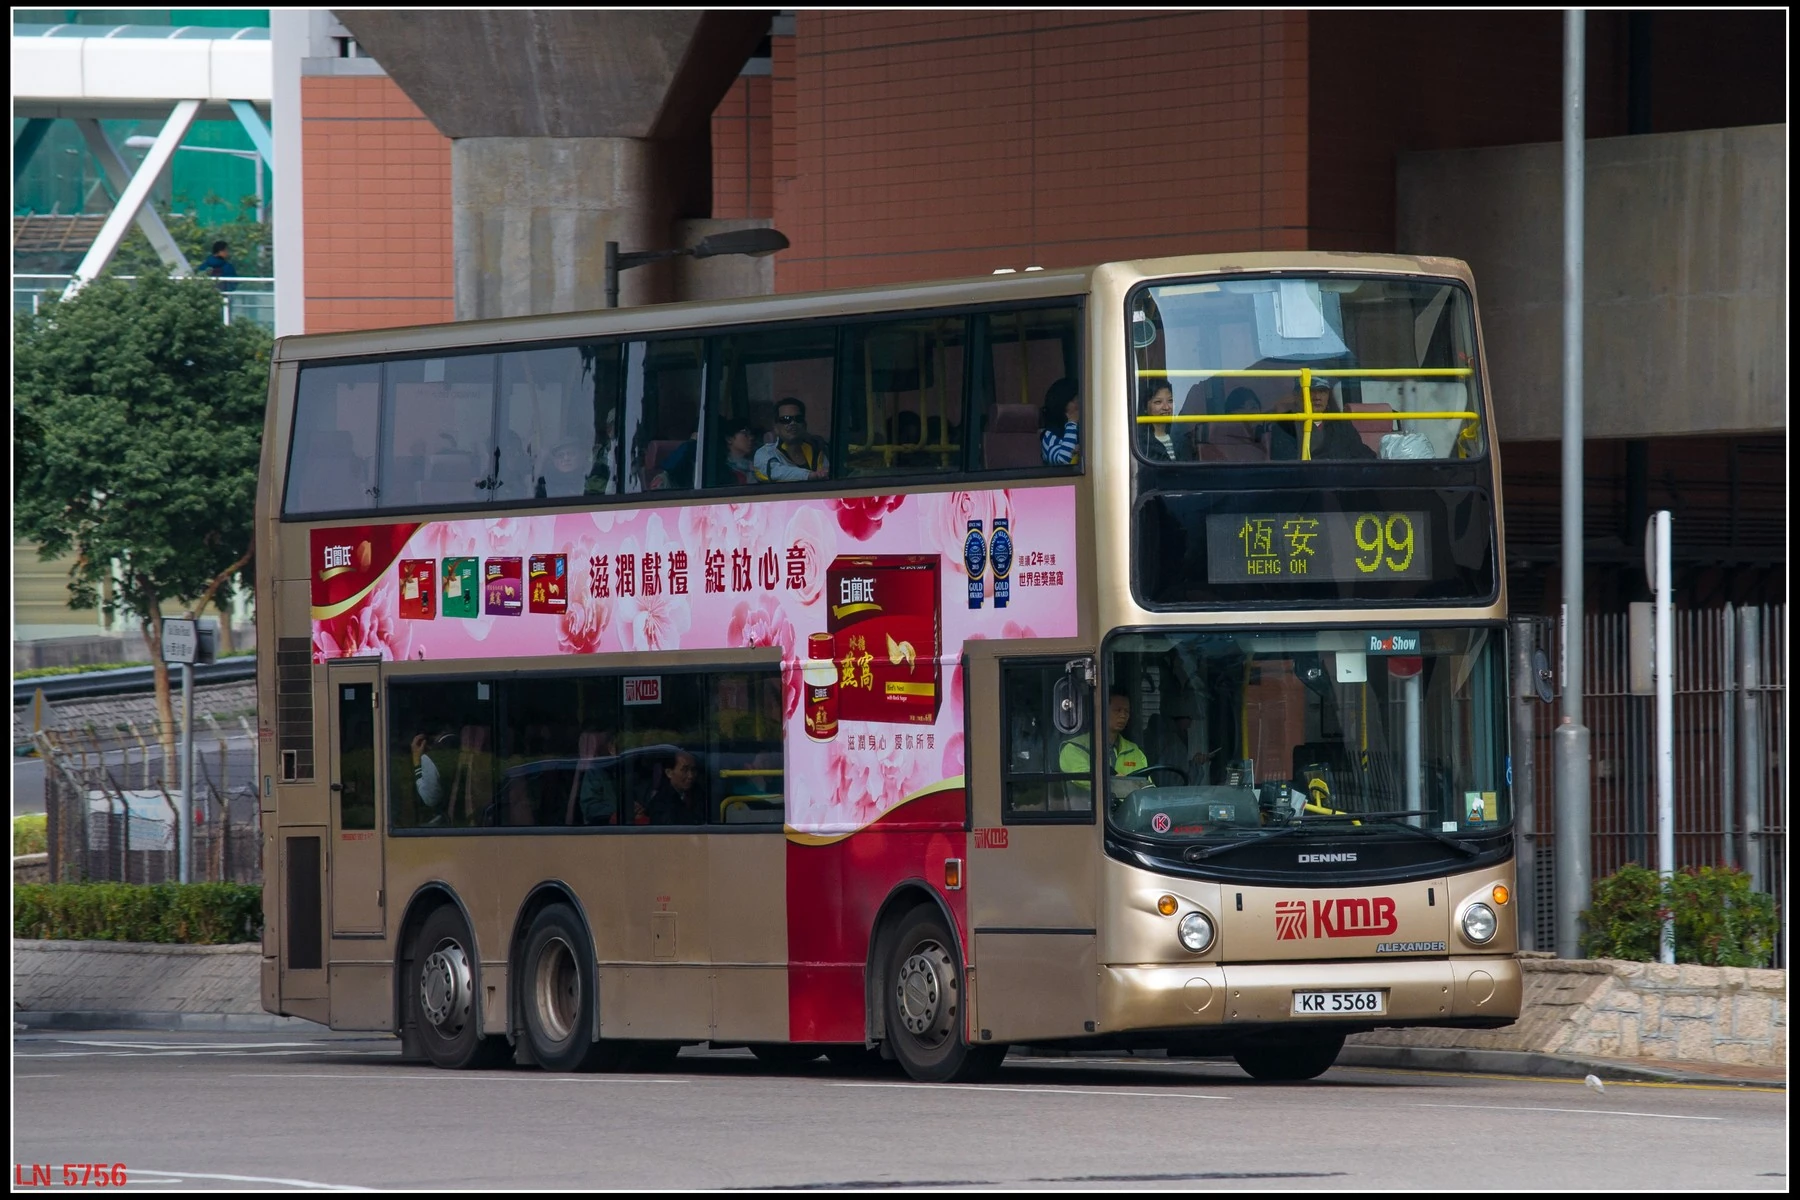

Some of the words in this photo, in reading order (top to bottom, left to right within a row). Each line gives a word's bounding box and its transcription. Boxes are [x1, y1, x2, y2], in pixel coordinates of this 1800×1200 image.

[1239, 516, 1319, 557] 恆安
[1355, 513, 1414, 573] 99
[324, 545, 352, 568] 白蘭氏
[1247, 560, 1282, 574] HENG
[1289, 559, 1307, 574] ON
[589, 550, 689, 598] 滋潤獻禮
[704, 545, 807, 594] 綻放心意
[840, 577, 875, 604] 白蘭氏
[968, 582, 983, 592] GOLD
[994, 581, 1009, 591] GOLD
[840, 651, 874, 691] 燕窩
[847, 734, 886, 751] 滋潤身心
[895, 733, 935, 750] 愛你所愛
[1298, 853, 1357, 864] DENNIS
[1312, 896, 1398, 939] KMB
[1376, 941, 1446, 953] ALEXANDER
[1302, 994, 1326, 1011] KR
[1331, 993, 1377, 1011] 5568
